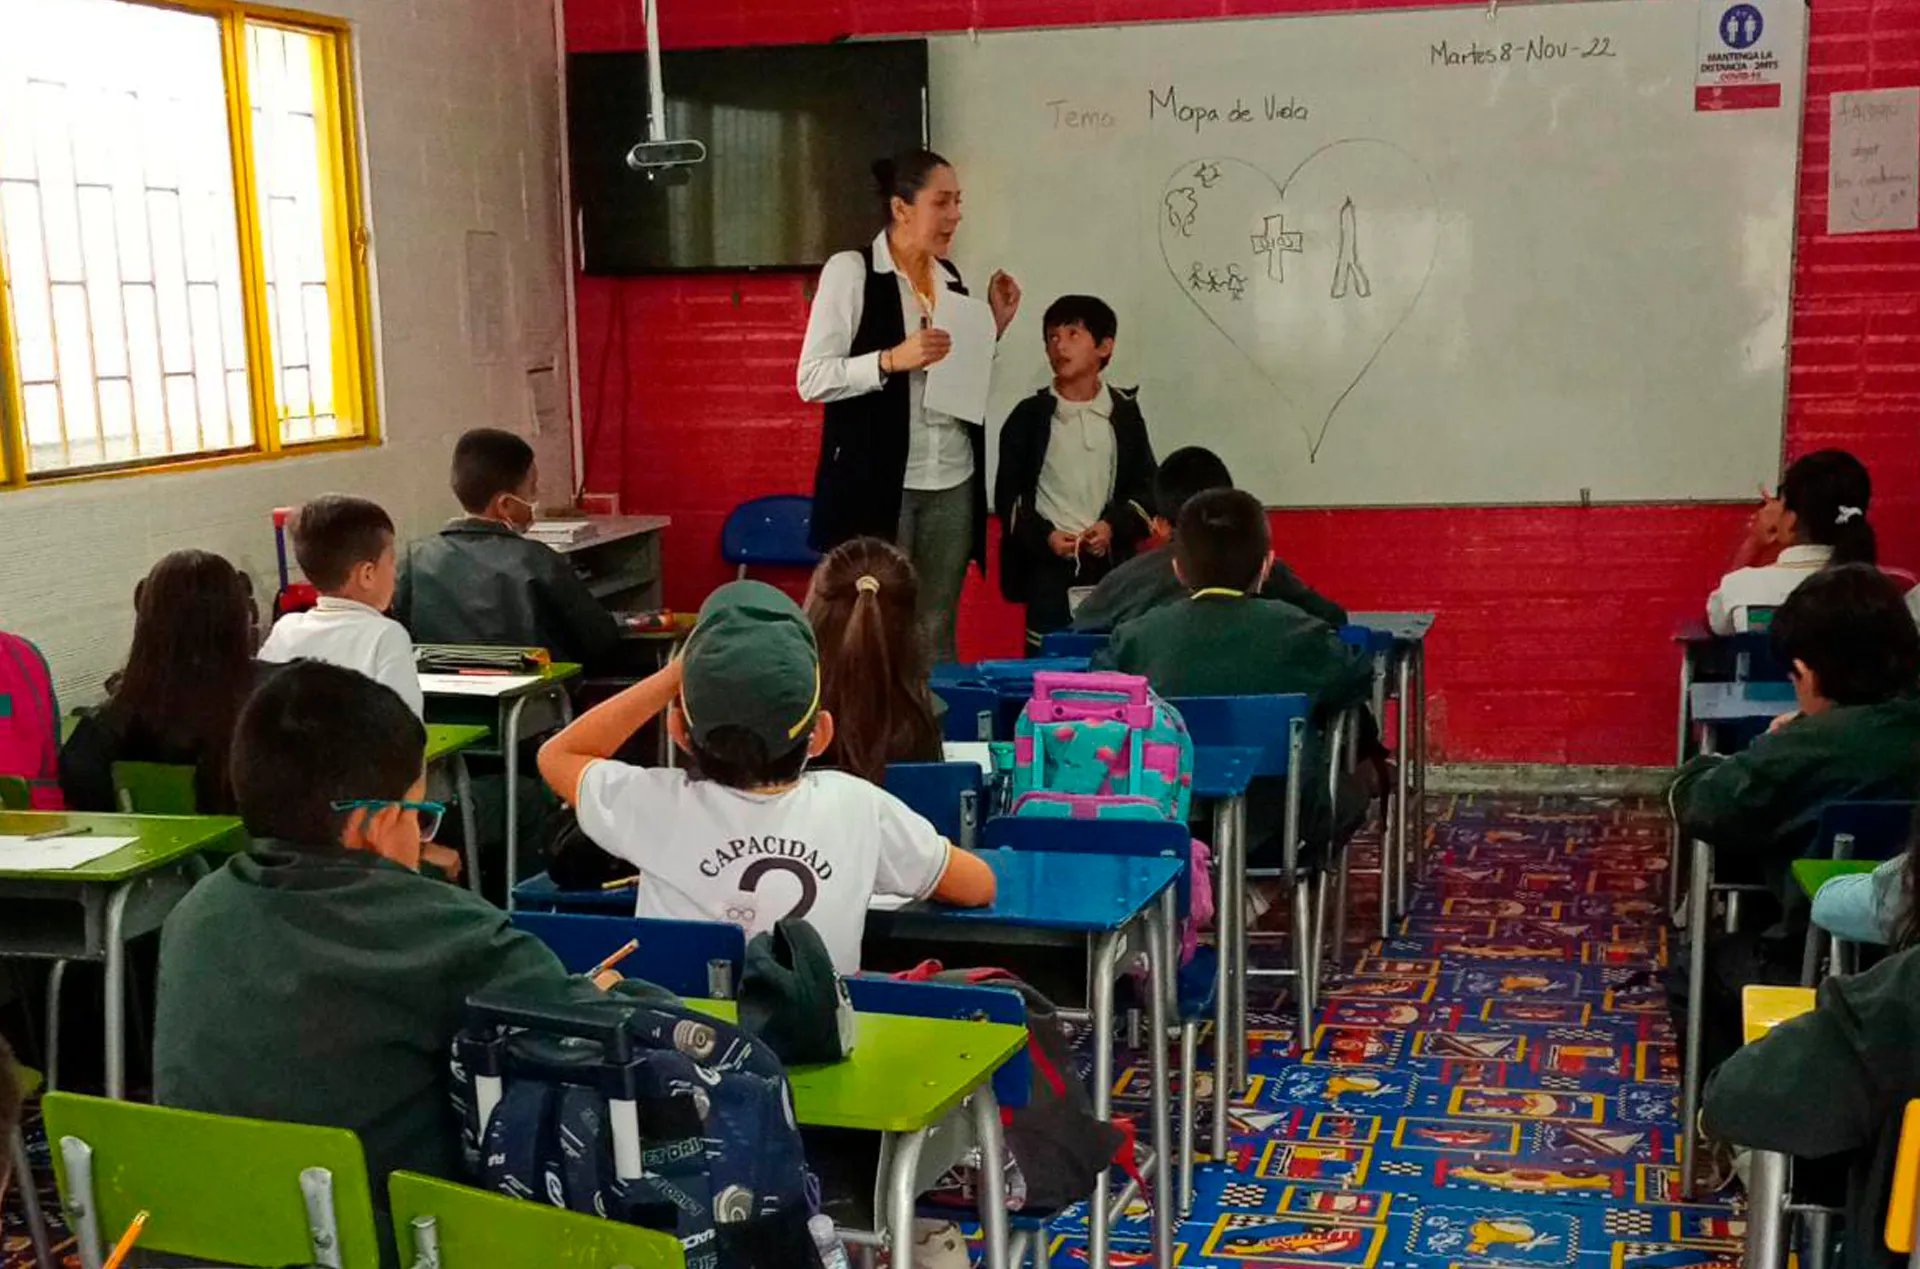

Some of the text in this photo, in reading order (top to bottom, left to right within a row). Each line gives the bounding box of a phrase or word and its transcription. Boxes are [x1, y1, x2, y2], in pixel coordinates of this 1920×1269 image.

[1430, 40, 1497, 66] Martes
[1707, 52, 1758, 62] MANTENGA
[1148, 85, 1219, 134] Mapa
[1227, 99, 1254, 122] de
[1264, 94, 1309, 121] Vida
[699, 834, 833, 881] CAPACIDAD
